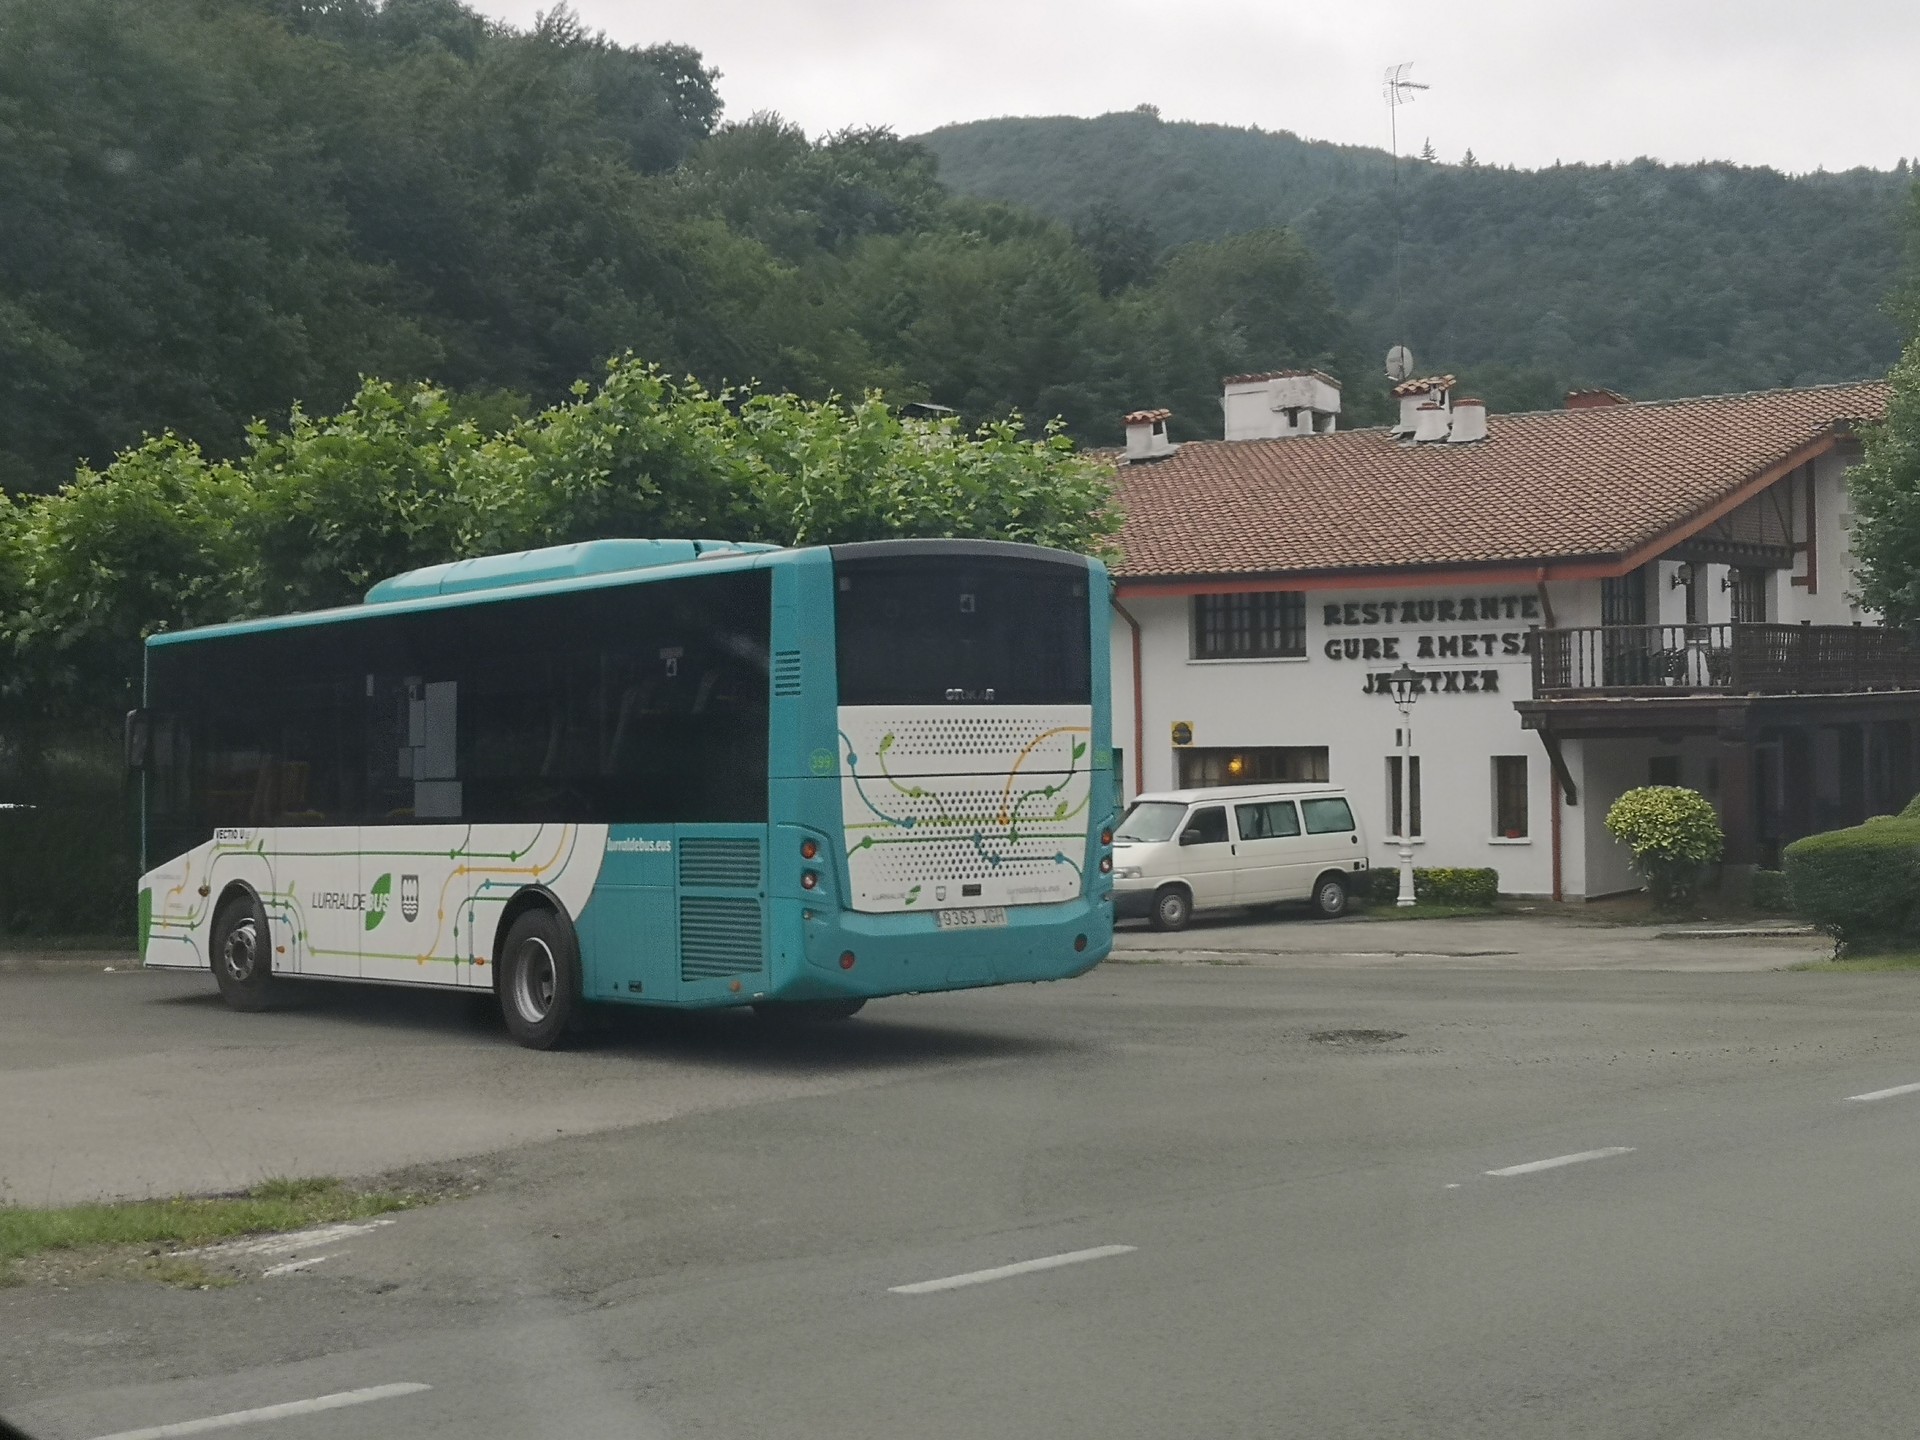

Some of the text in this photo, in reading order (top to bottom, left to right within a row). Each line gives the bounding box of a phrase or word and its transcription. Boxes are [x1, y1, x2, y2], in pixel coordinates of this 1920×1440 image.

[1323, 595, 1540, 626] RESTAURANTE
[1324, 637, 1400, 660] GURE
[943, 910, 977, 926] 9363
